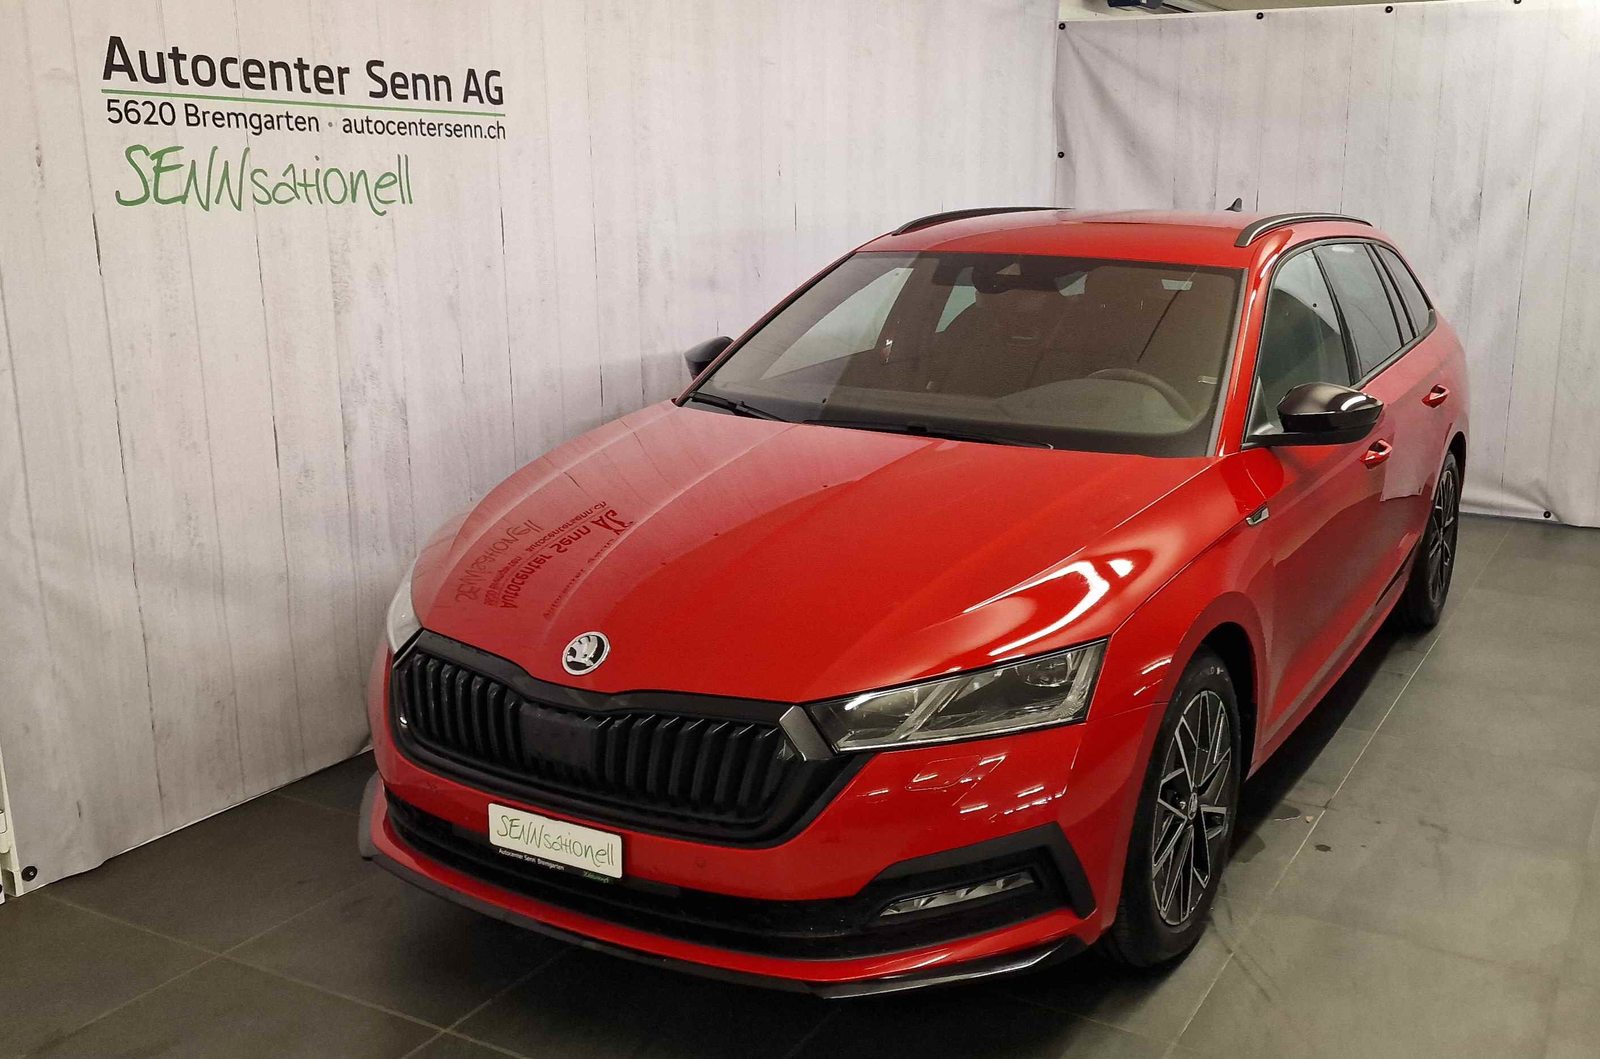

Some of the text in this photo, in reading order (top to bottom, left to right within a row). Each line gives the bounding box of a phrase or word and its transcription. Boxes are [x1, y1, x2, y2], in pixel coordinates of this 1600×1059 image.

[103, 35, 504, 106] Autocenter Senn AG
[106, 99, 506, 140] 5620 Bremgarten autocentersenn.ch
[115, 144, 414, 216] SENNsationell
[497, 814, 615, 868] SENNsationell
